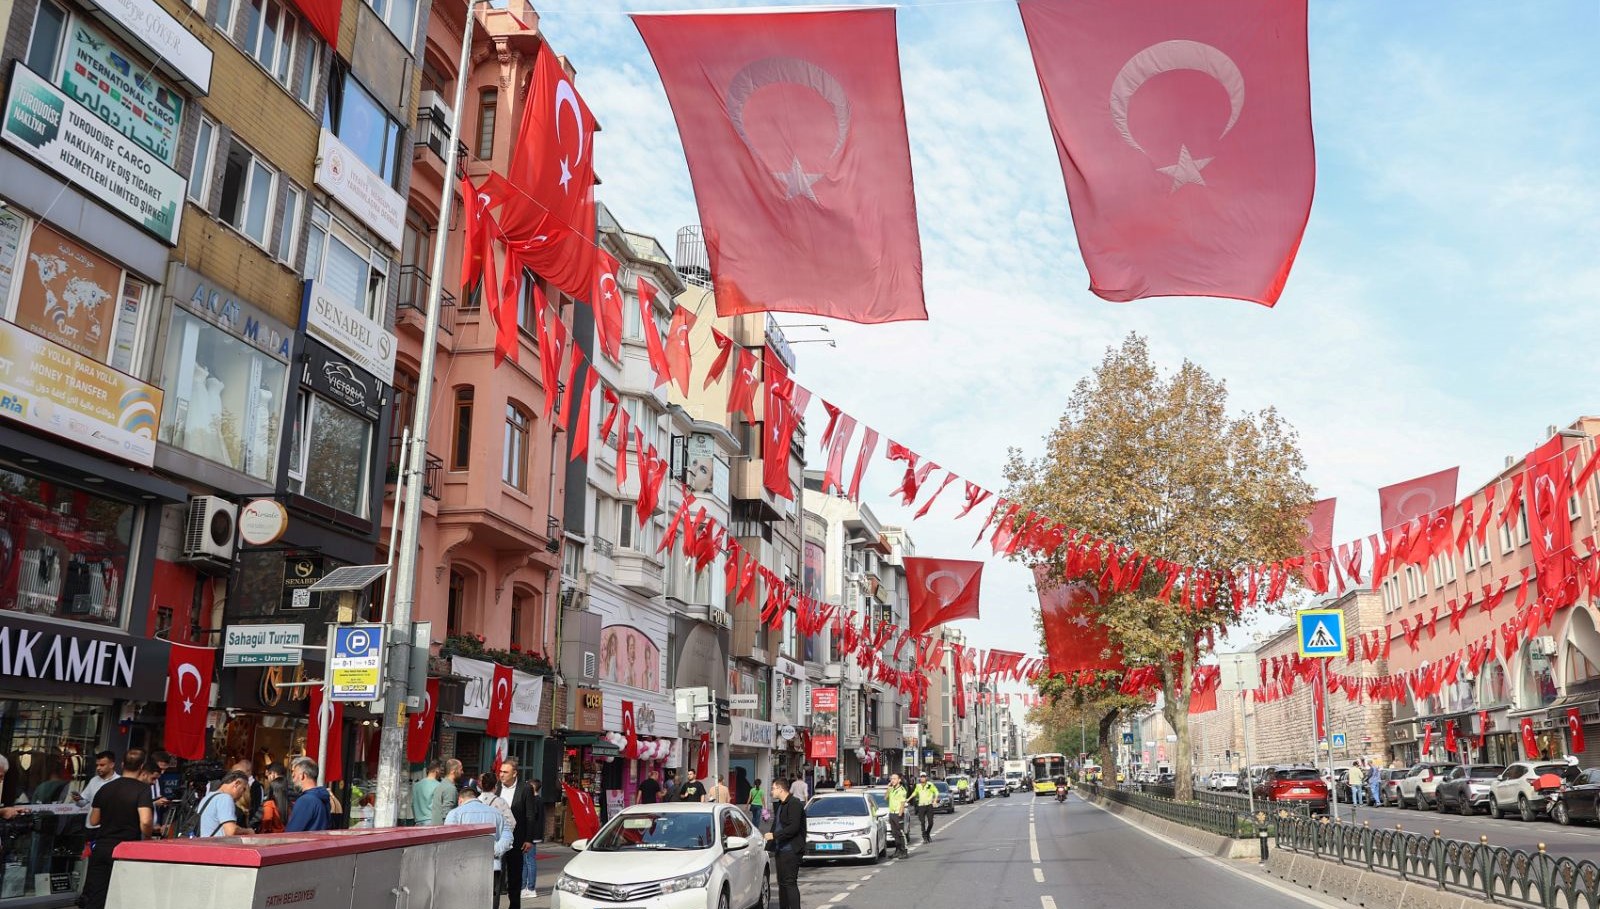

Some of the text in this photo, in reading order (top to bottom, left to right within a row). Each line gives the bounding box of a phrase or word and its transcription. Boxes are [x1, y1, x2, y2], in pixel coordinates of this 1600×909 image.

[77, 47, 175, 127] INTERNATIONAL CARGO
[63, 130, 106, 165] NAKLİYAT
[106, 156, 117, 172] VE
[116, 164, 131, 185] DIŞ
[132, 173, 163, 202] TİCARET
[117, 145, 152, 175] CARGO
[60, 148, 109, 188] HİZMETLERİ
[109, 176, 140, 208] LİMİTED
[139, 198, 169, 226] ŞİRKETİ
[57, 320, 79, 339] UPT
[315, 296, 373, 349] SENABEL
[30, 361, 108, 401] MONEY TRANSFER
[47, 349, 71, 367] YOLLA
[74, 361, 96, 378] PARA
[96, 370, 119, 387] YOLLA
[1, 395, 23, 415] Ria
[228, 630, 300, 649] Sahagül Turizm
[352, 635, 366, 649] P
[240, 655, 257, 663] Hac
[264, 655, 287, 663] Umre
